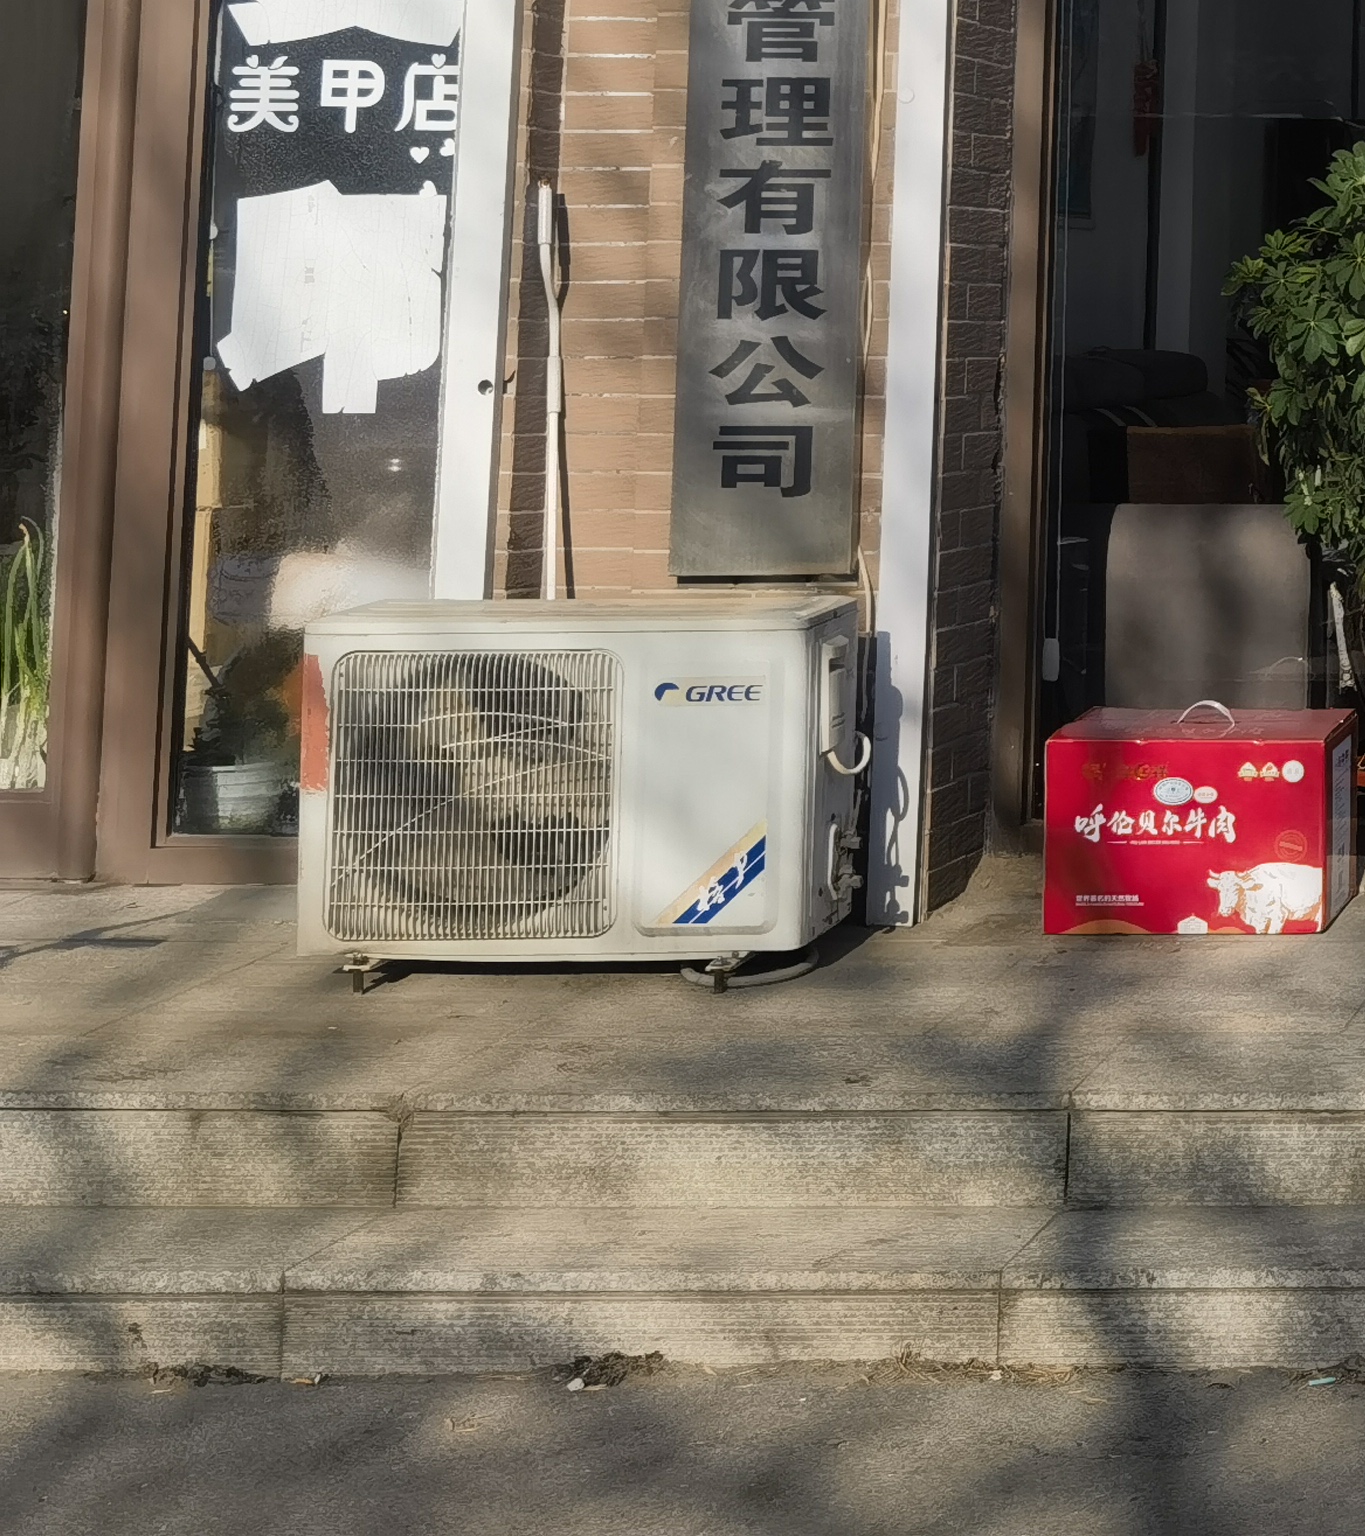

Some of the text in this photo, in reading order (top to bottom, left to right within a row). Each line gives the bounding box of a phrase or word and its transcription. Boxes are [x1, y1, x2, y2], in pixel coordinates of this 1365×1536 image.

[227, 54, 458, 133] 美甲店
[686, 685, 762, 702] GREE
[1074, 803, 1236, 843] 呼伦贝尔牛肉
